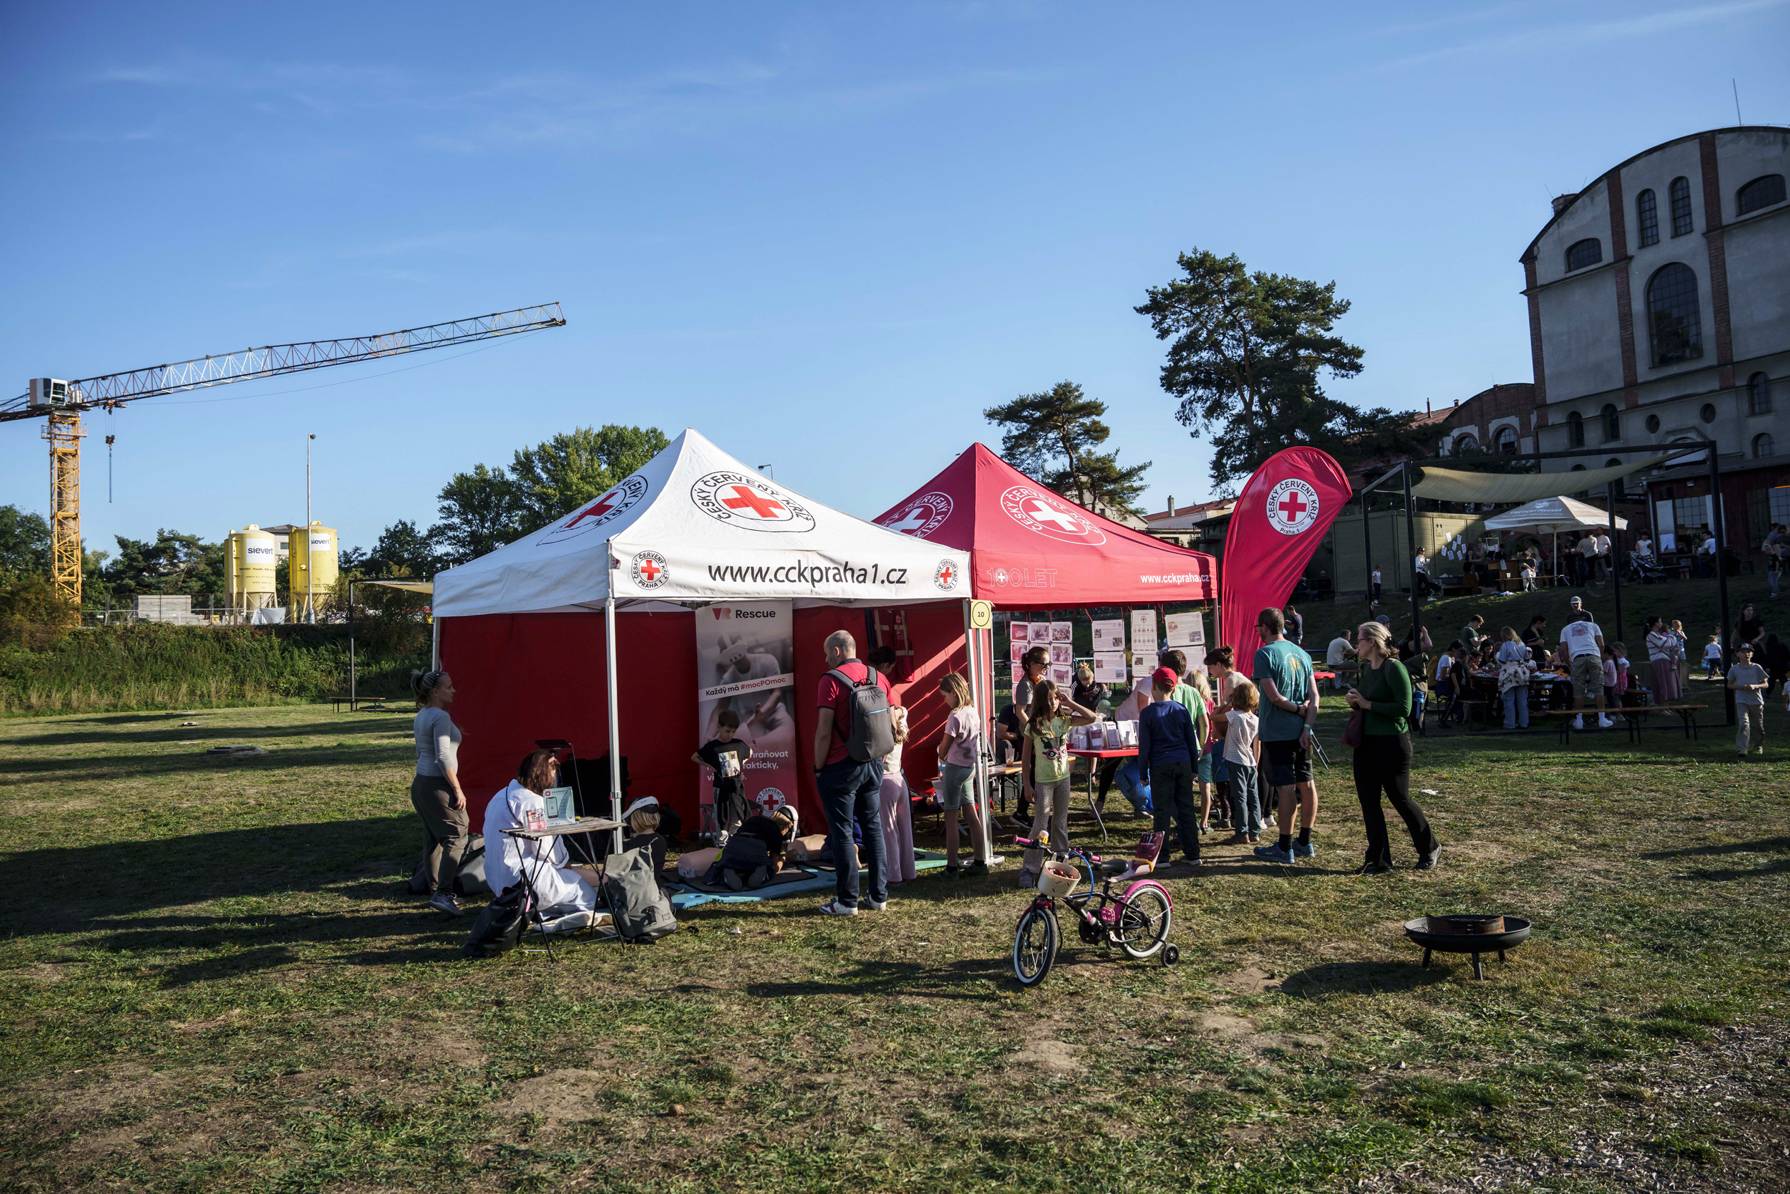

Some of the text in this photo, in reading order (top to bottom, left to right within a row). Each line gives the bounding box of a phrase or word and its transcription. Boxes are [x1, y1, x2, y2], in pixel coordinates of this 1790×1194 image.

[247, 547, 273, 555] sievert
[708, 559, 907, 588] www.cckpraha1.cz
[1140, 572, 1209, 585] www.cckpraha.cz
[735, 609, 776, 619] Rescue
[705, 686, 726, 696] Každý
